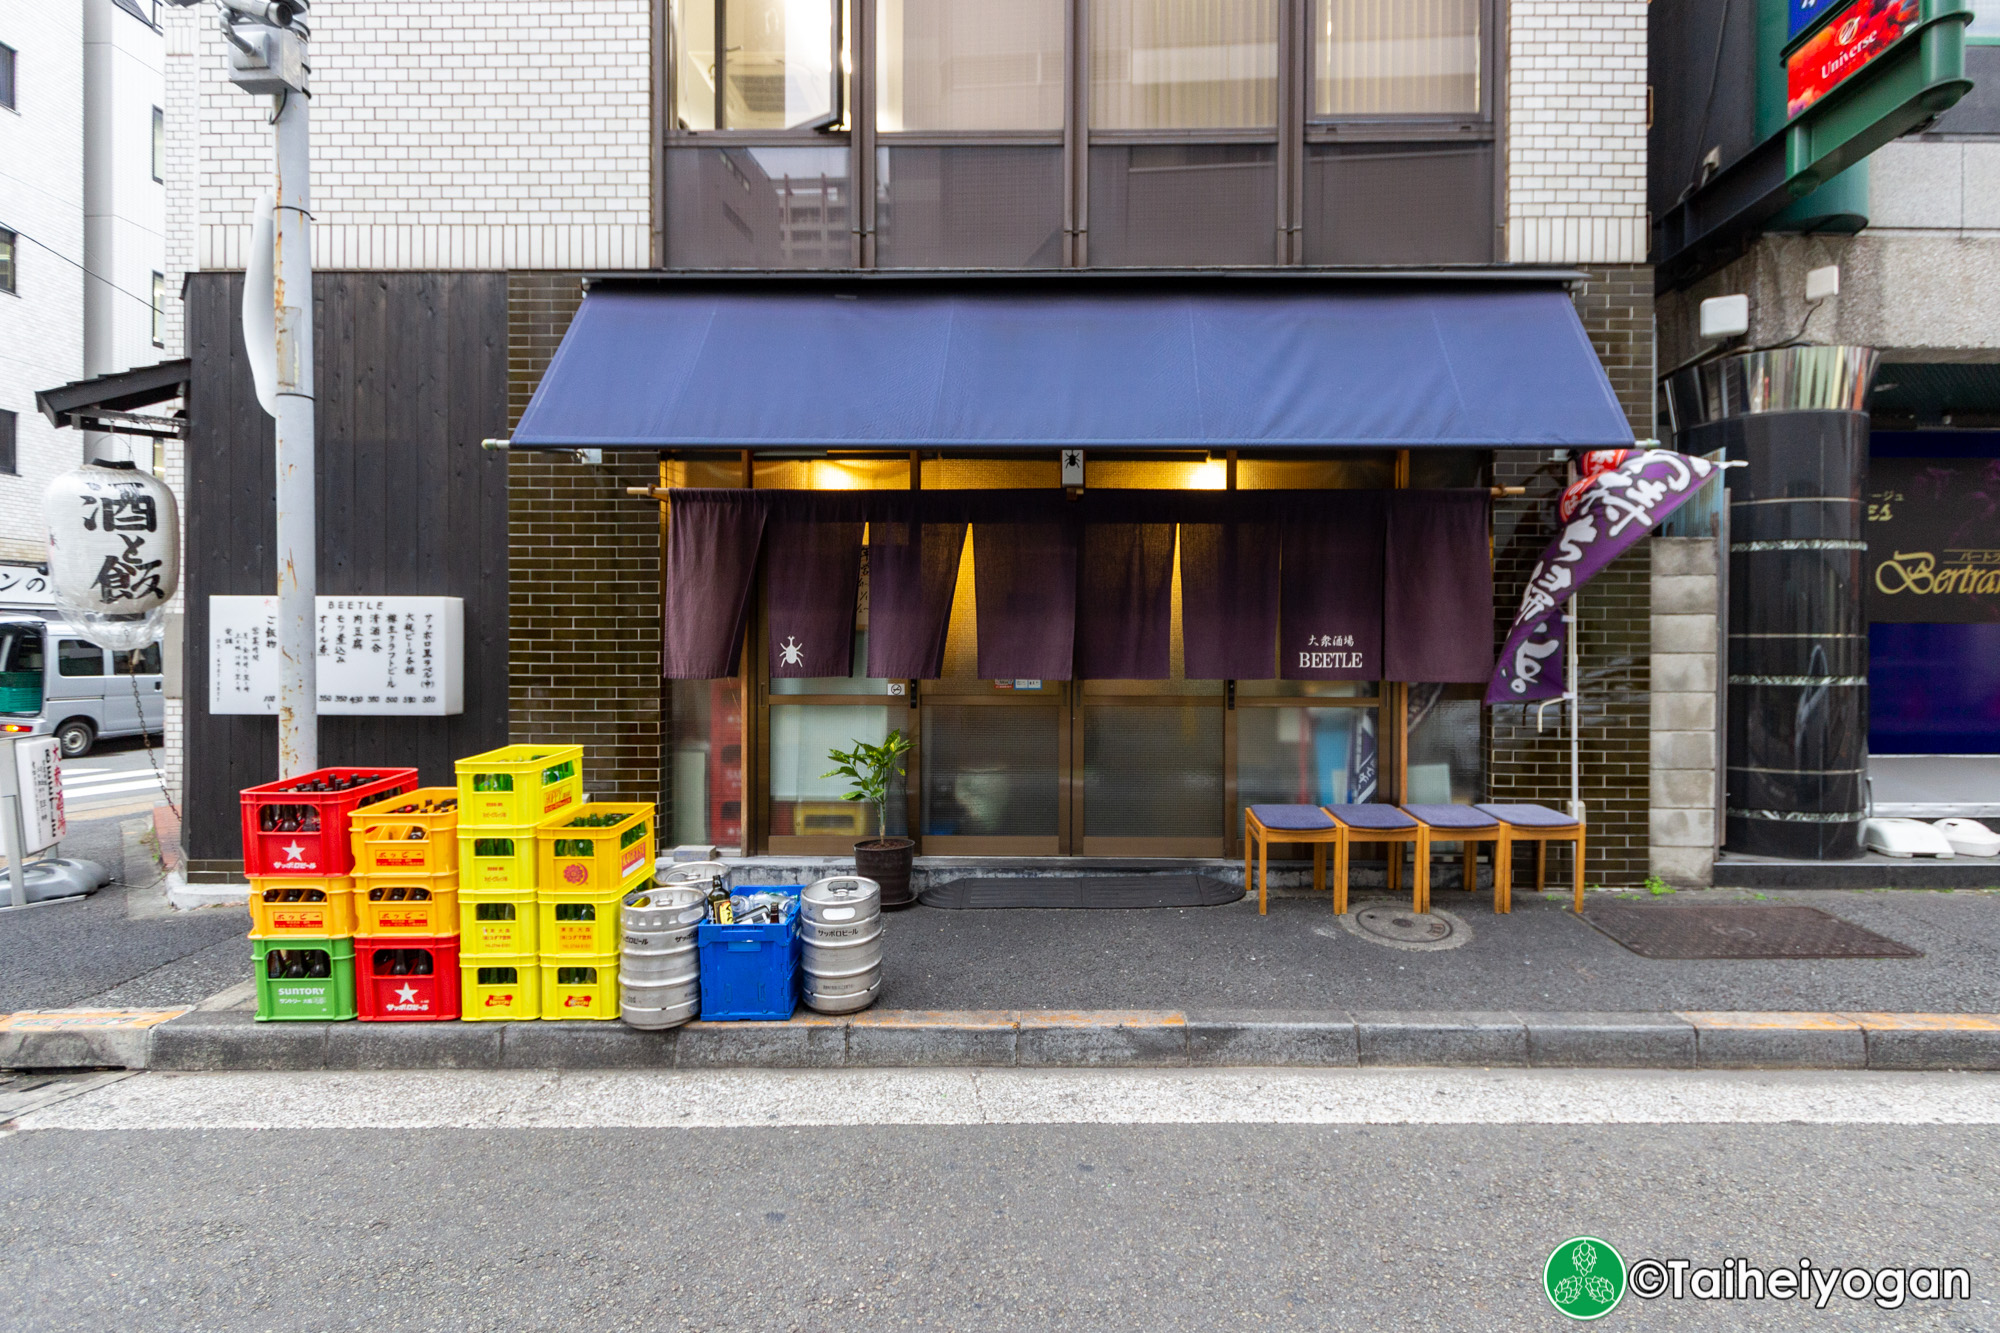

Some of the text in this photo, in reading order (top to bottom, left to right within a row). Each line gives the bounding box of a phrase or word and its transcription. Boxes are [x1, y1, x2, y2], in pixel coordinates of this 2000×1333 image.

[1821, 29, 1877, 79] Universe
[328, 601, 383, 609] BEETLE
[1307, 634, 1354, 648] 大衆酒場
[1299, 652, 1363, 668] BEETLE
[818, 928, 858, 937] サッポロビール
[386, 1003, 429, 1011] サッポロビール
